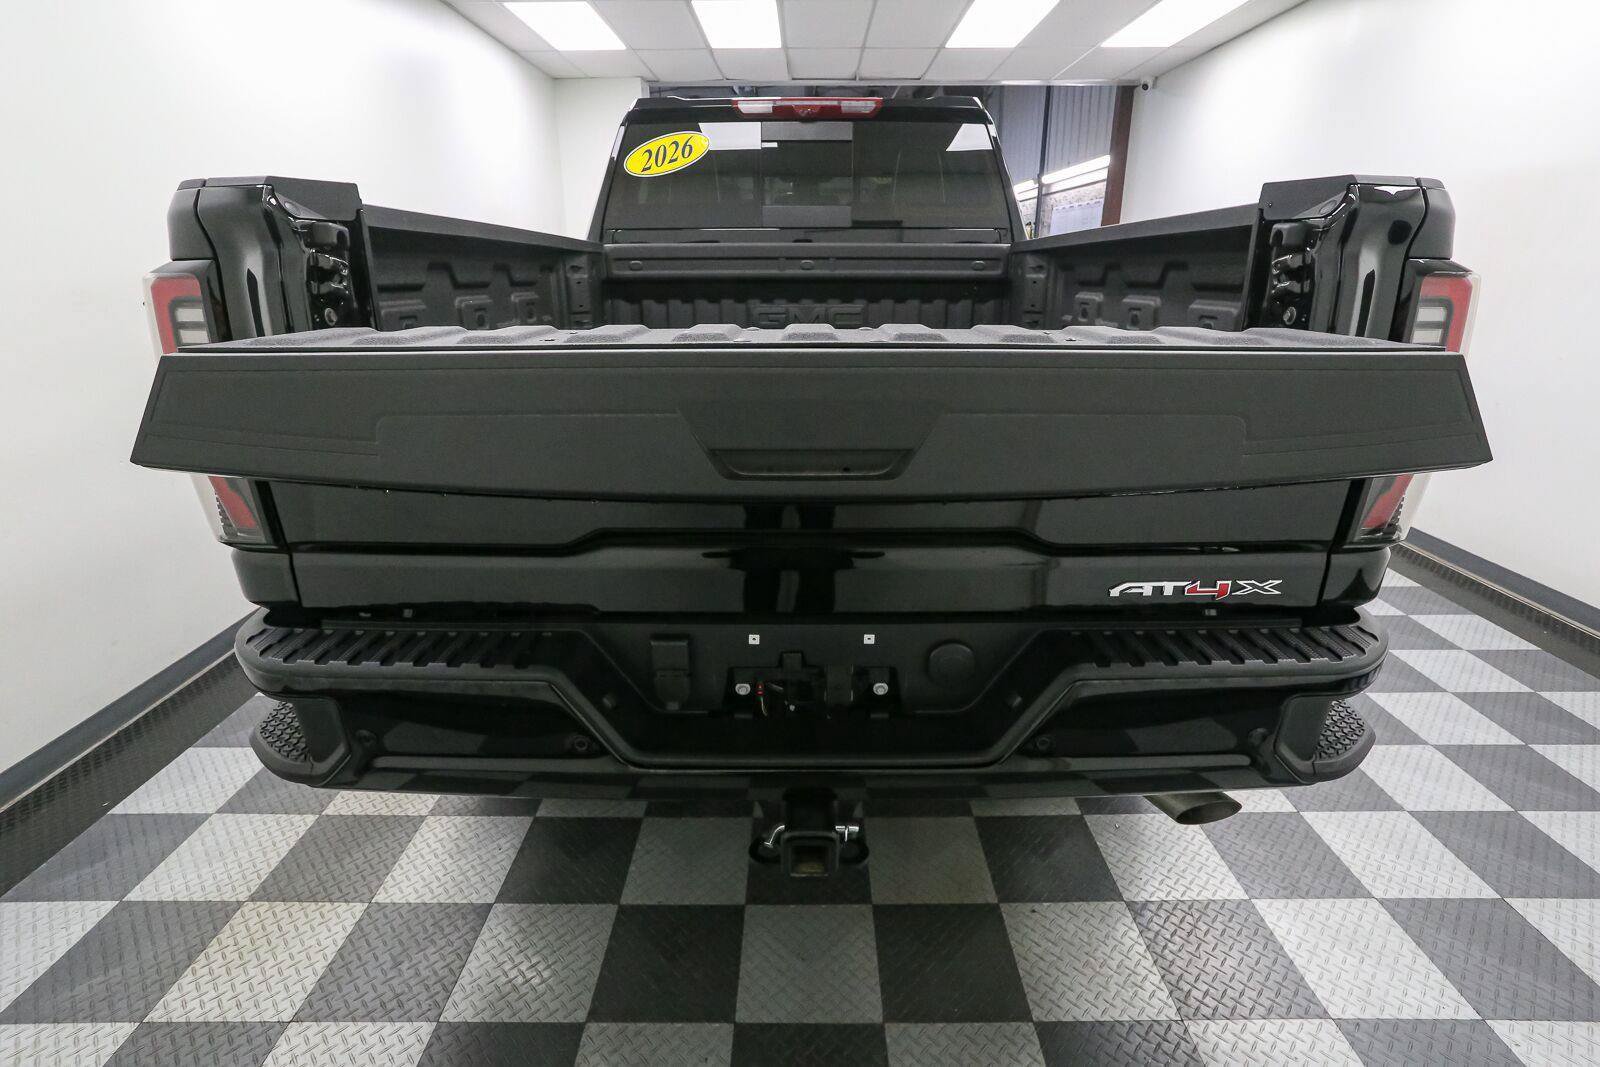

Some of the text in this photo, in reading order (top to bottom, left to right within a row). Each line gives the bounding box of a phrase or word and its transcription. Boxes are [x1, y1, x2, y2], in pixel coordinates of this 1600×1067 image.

[640, 135, 694, 173] 2026
[752, 305, 863, 326] GMC
[1109, 579, 1283, 601] AT4X
